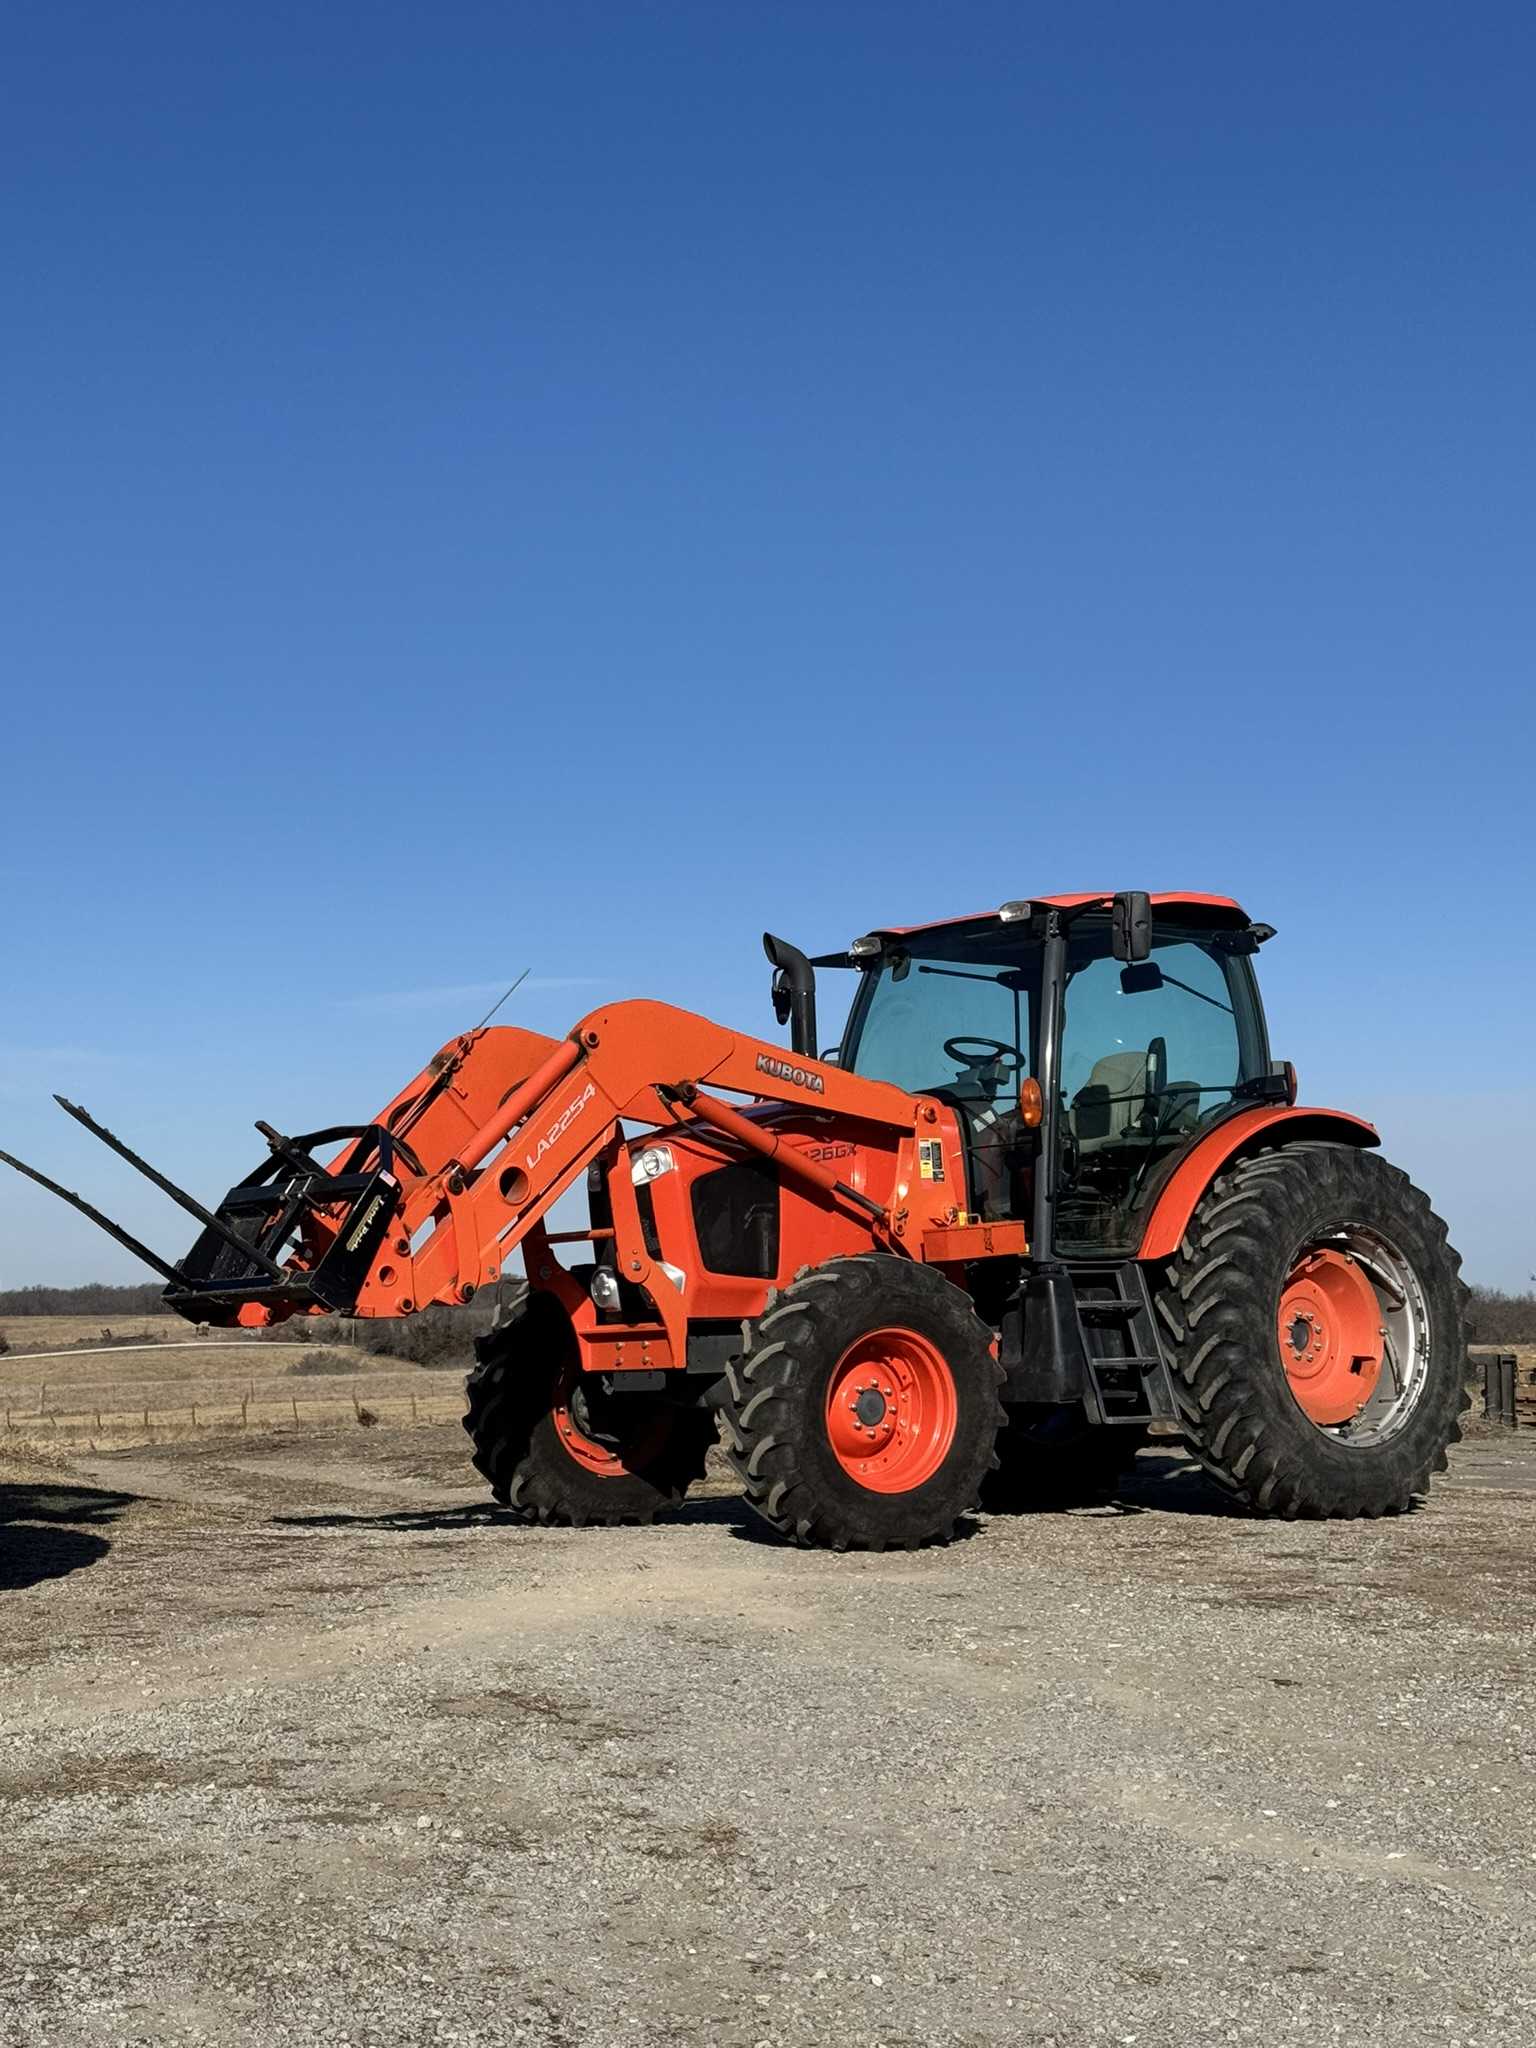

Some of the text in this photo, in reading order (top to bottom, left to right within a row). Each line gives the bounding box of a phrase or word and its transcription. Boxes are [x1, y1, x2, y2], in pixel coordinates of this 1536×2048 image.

[756, 1052, 825, 1095] KUBOTA
[526, 1083, 595, 1168] LA2254
[802, 1143, 857, 1162] 26GX
